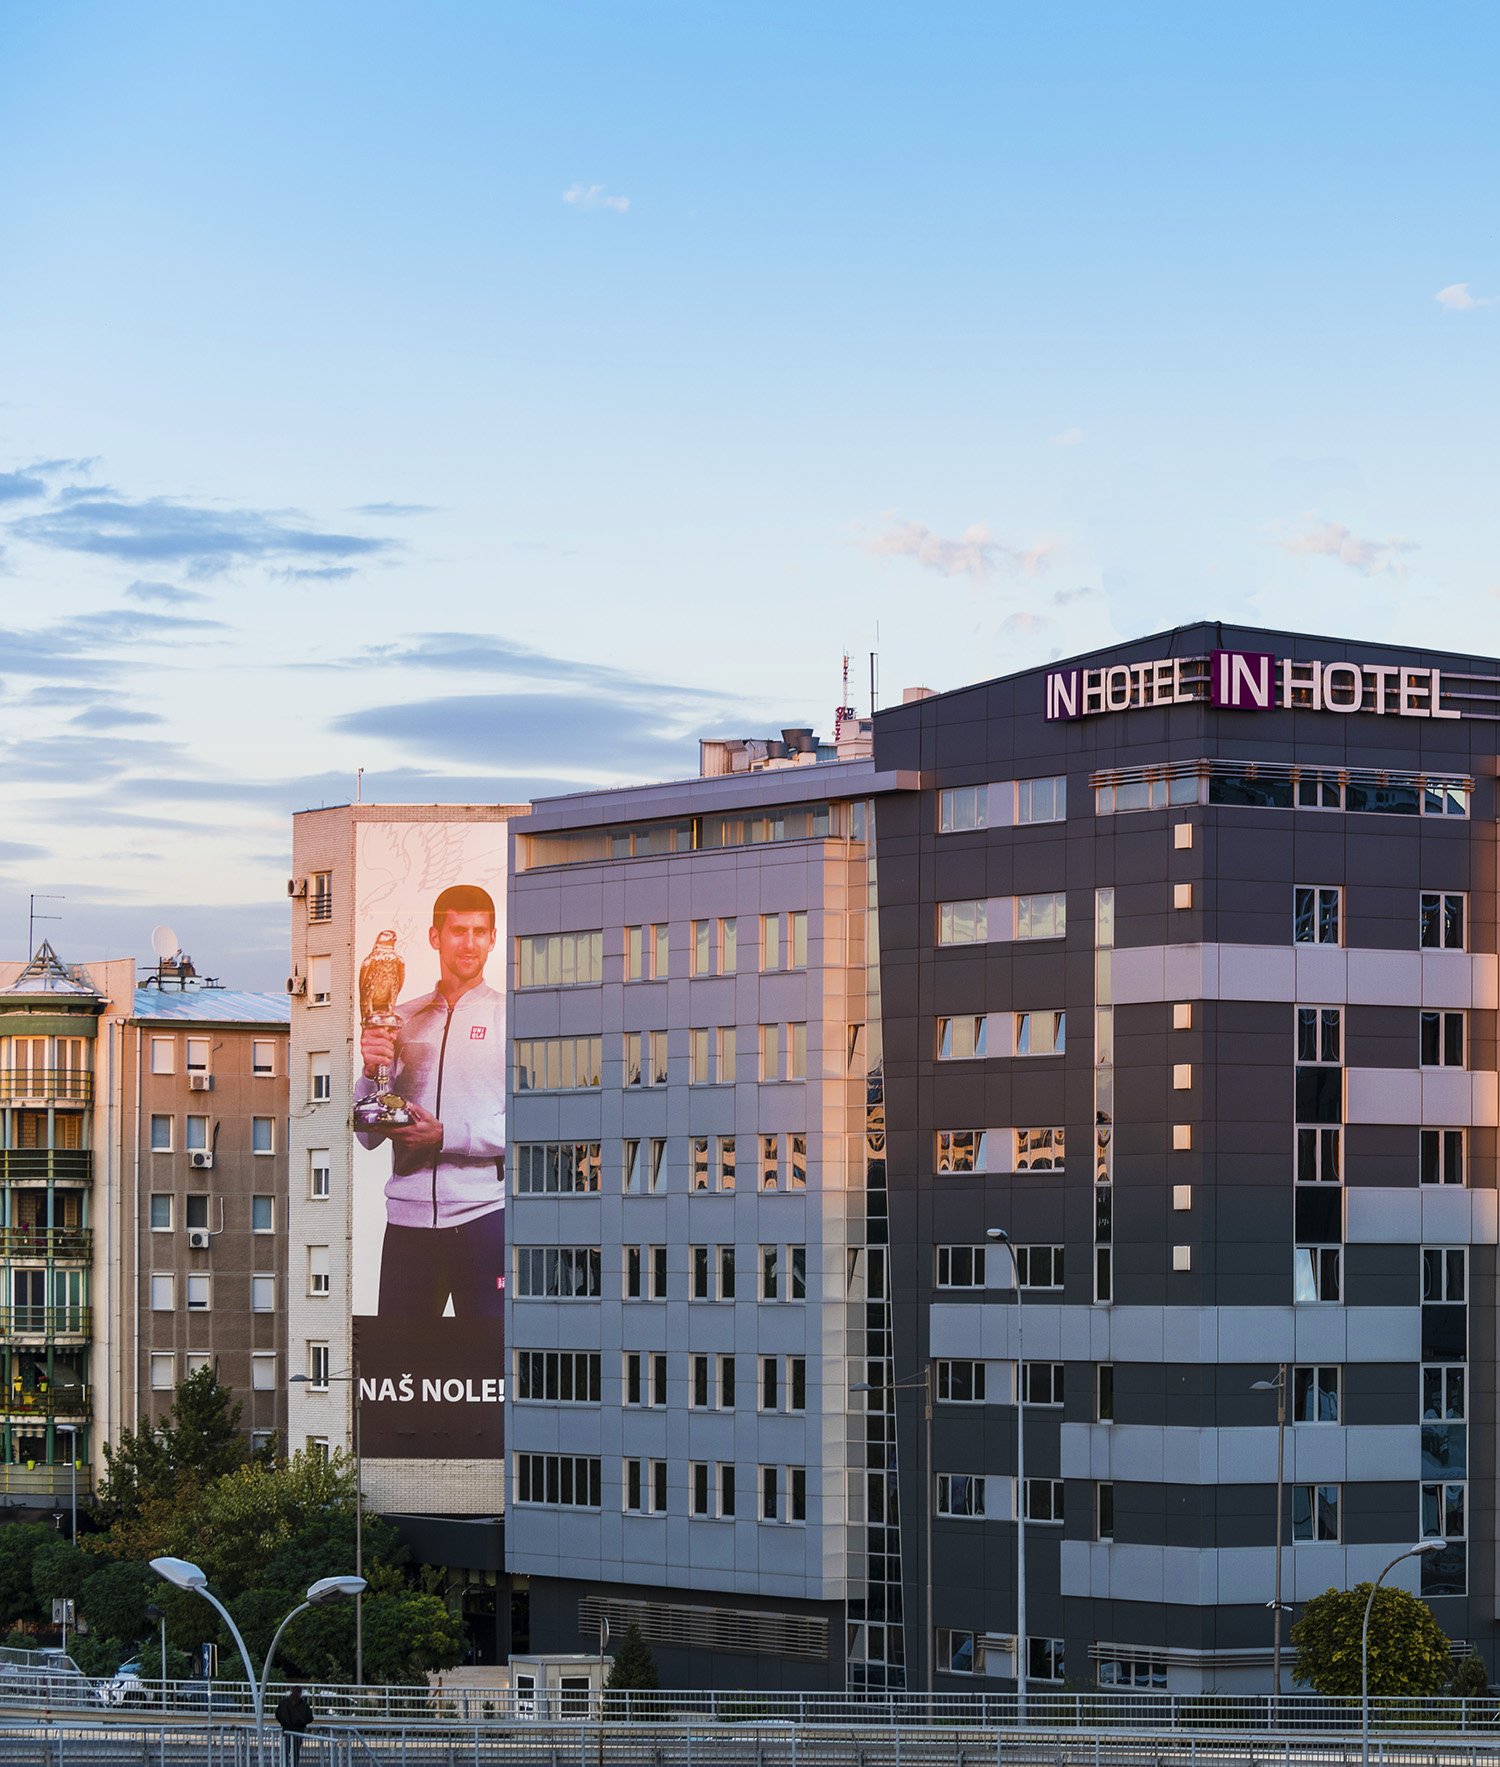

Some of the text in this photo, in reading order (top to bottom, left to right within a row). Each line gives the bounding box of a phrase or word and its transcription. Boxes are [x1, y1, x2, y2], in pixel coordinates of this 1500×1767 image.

[1047, 658, 1194, 719] IN HOTEL
[1220, 653, 1462, 720] IN HOTEL
[360, 1373, 505, 1402] NAŠ NOLE!
